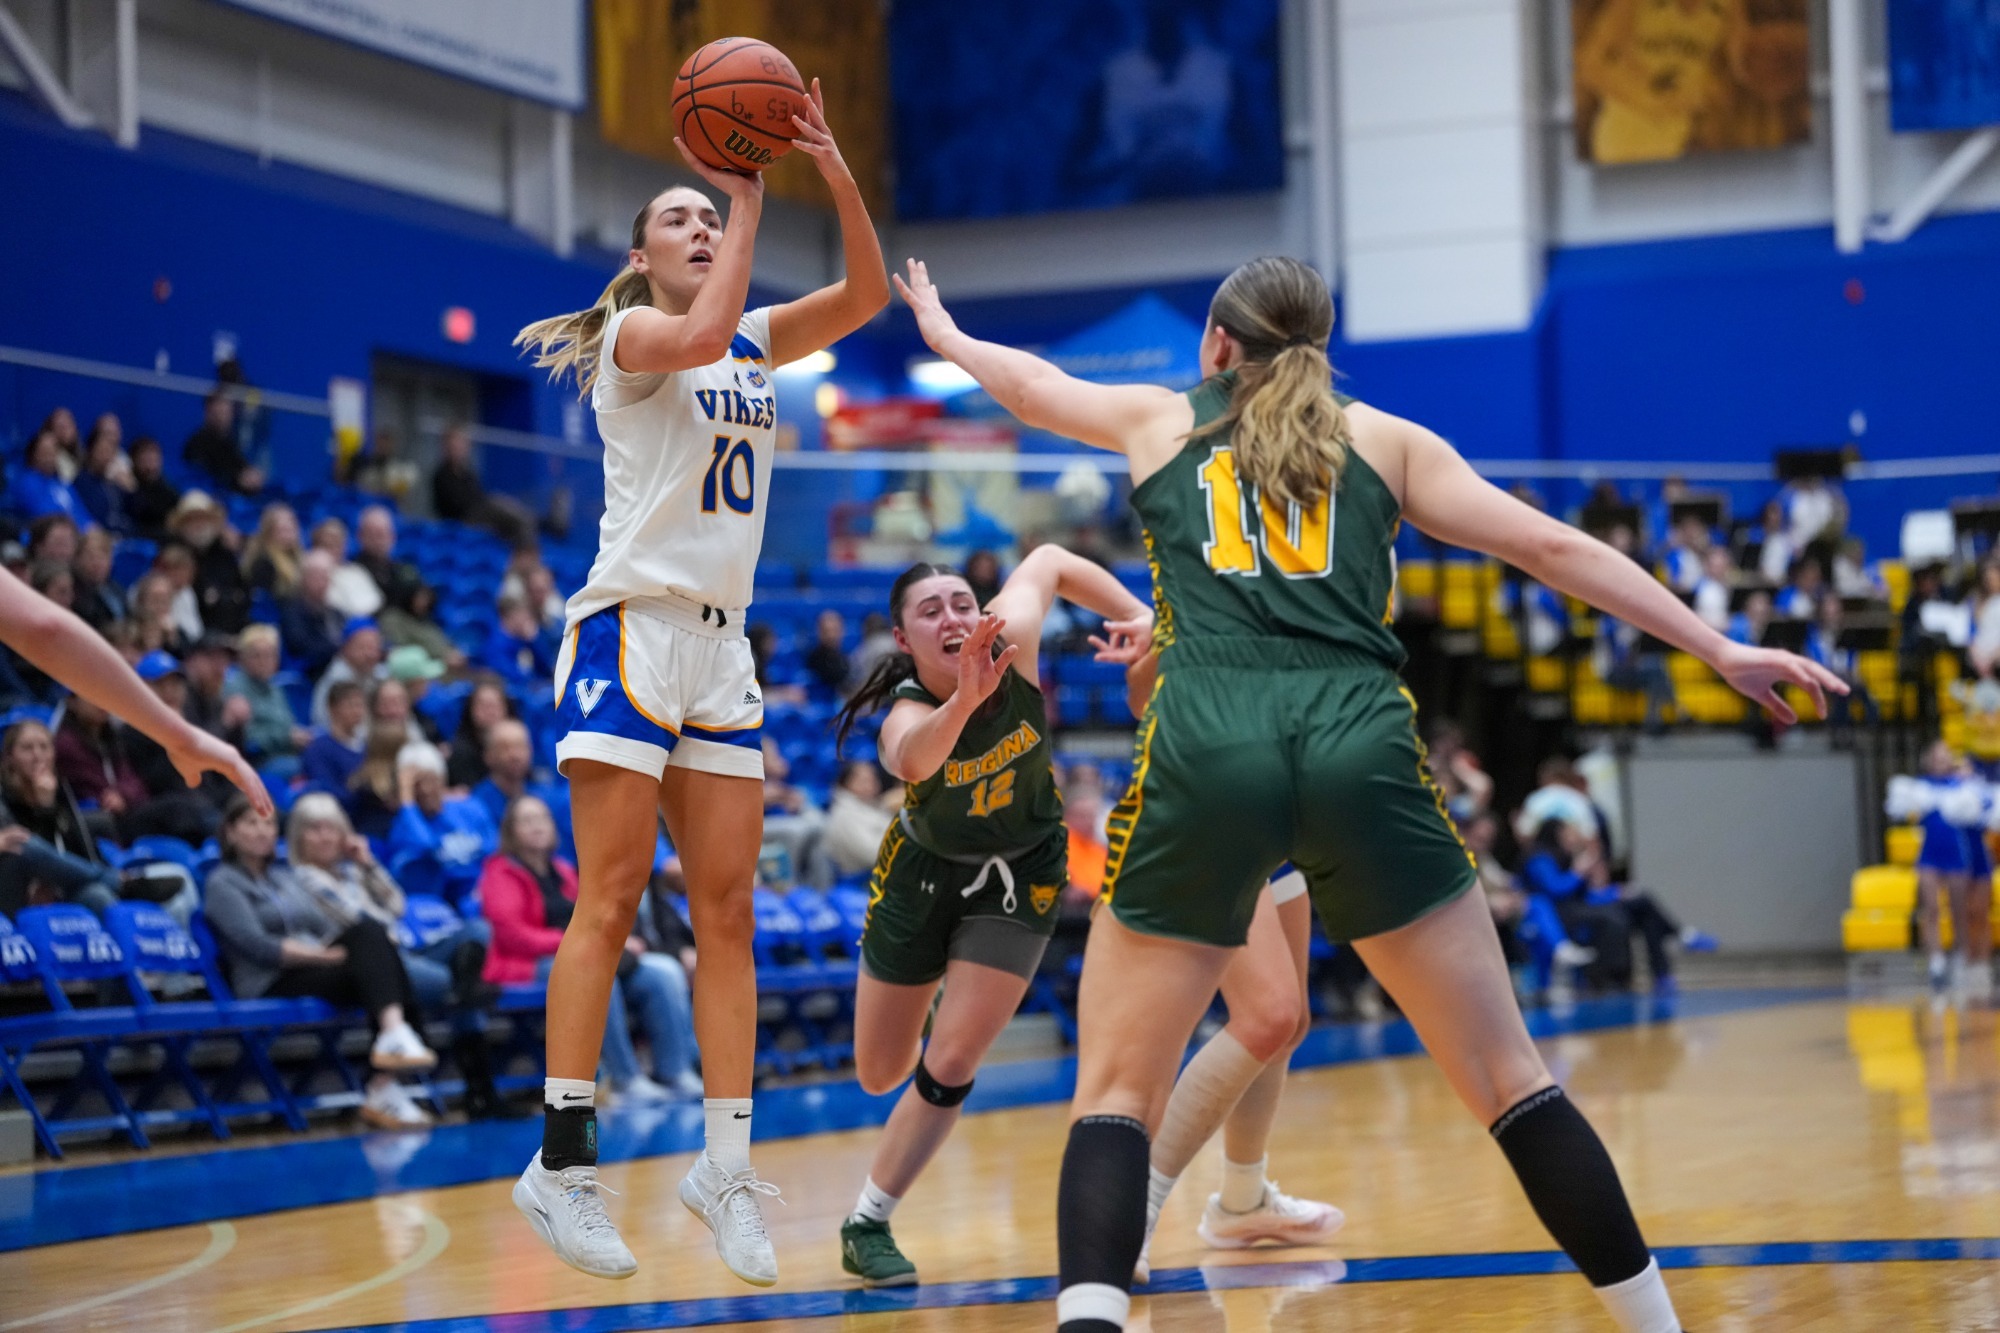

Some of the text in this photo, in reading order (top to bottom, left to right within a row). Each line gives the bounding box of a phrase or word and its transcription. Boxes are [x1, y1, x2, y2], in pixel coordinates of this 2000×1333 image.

[695, 388, 775, 430] VIKES
[701, 433, 754, 516] 10
[1197, 445, 1337, 580] 10
[575, 678, 612, 719] V
[944, 719, 1042, 787] REGINA
[967, 768, 1017, 818] 12
